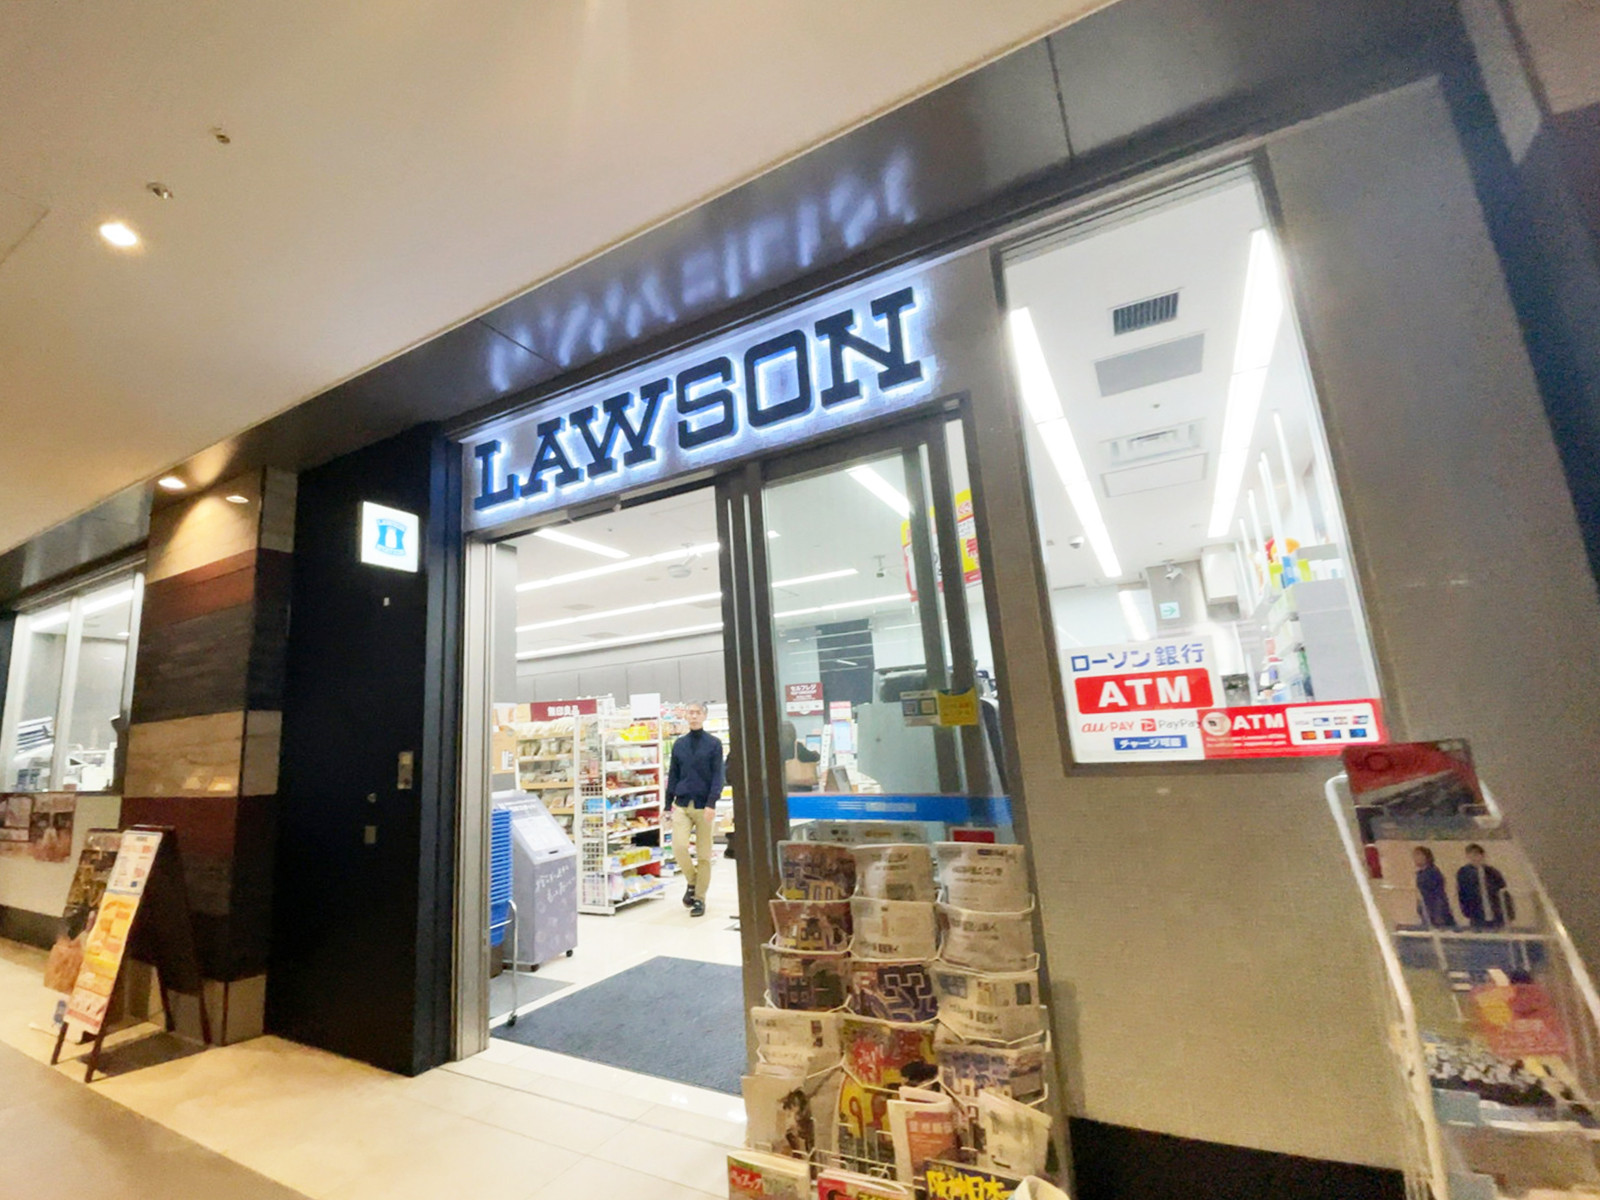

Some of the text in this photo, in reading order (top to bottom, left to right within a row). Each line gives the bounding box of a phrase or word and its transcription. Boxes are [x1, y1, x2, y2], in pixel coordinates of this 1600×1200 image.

[474, 286, 923, 510] LAWSON
[1071, 643, 1205, 673] ローソン銀行
[1098, 675, 1192, 708] ATM
[1110, 721, 1135, 732] PAY
[1232, 713, 1283, 731] ATM
